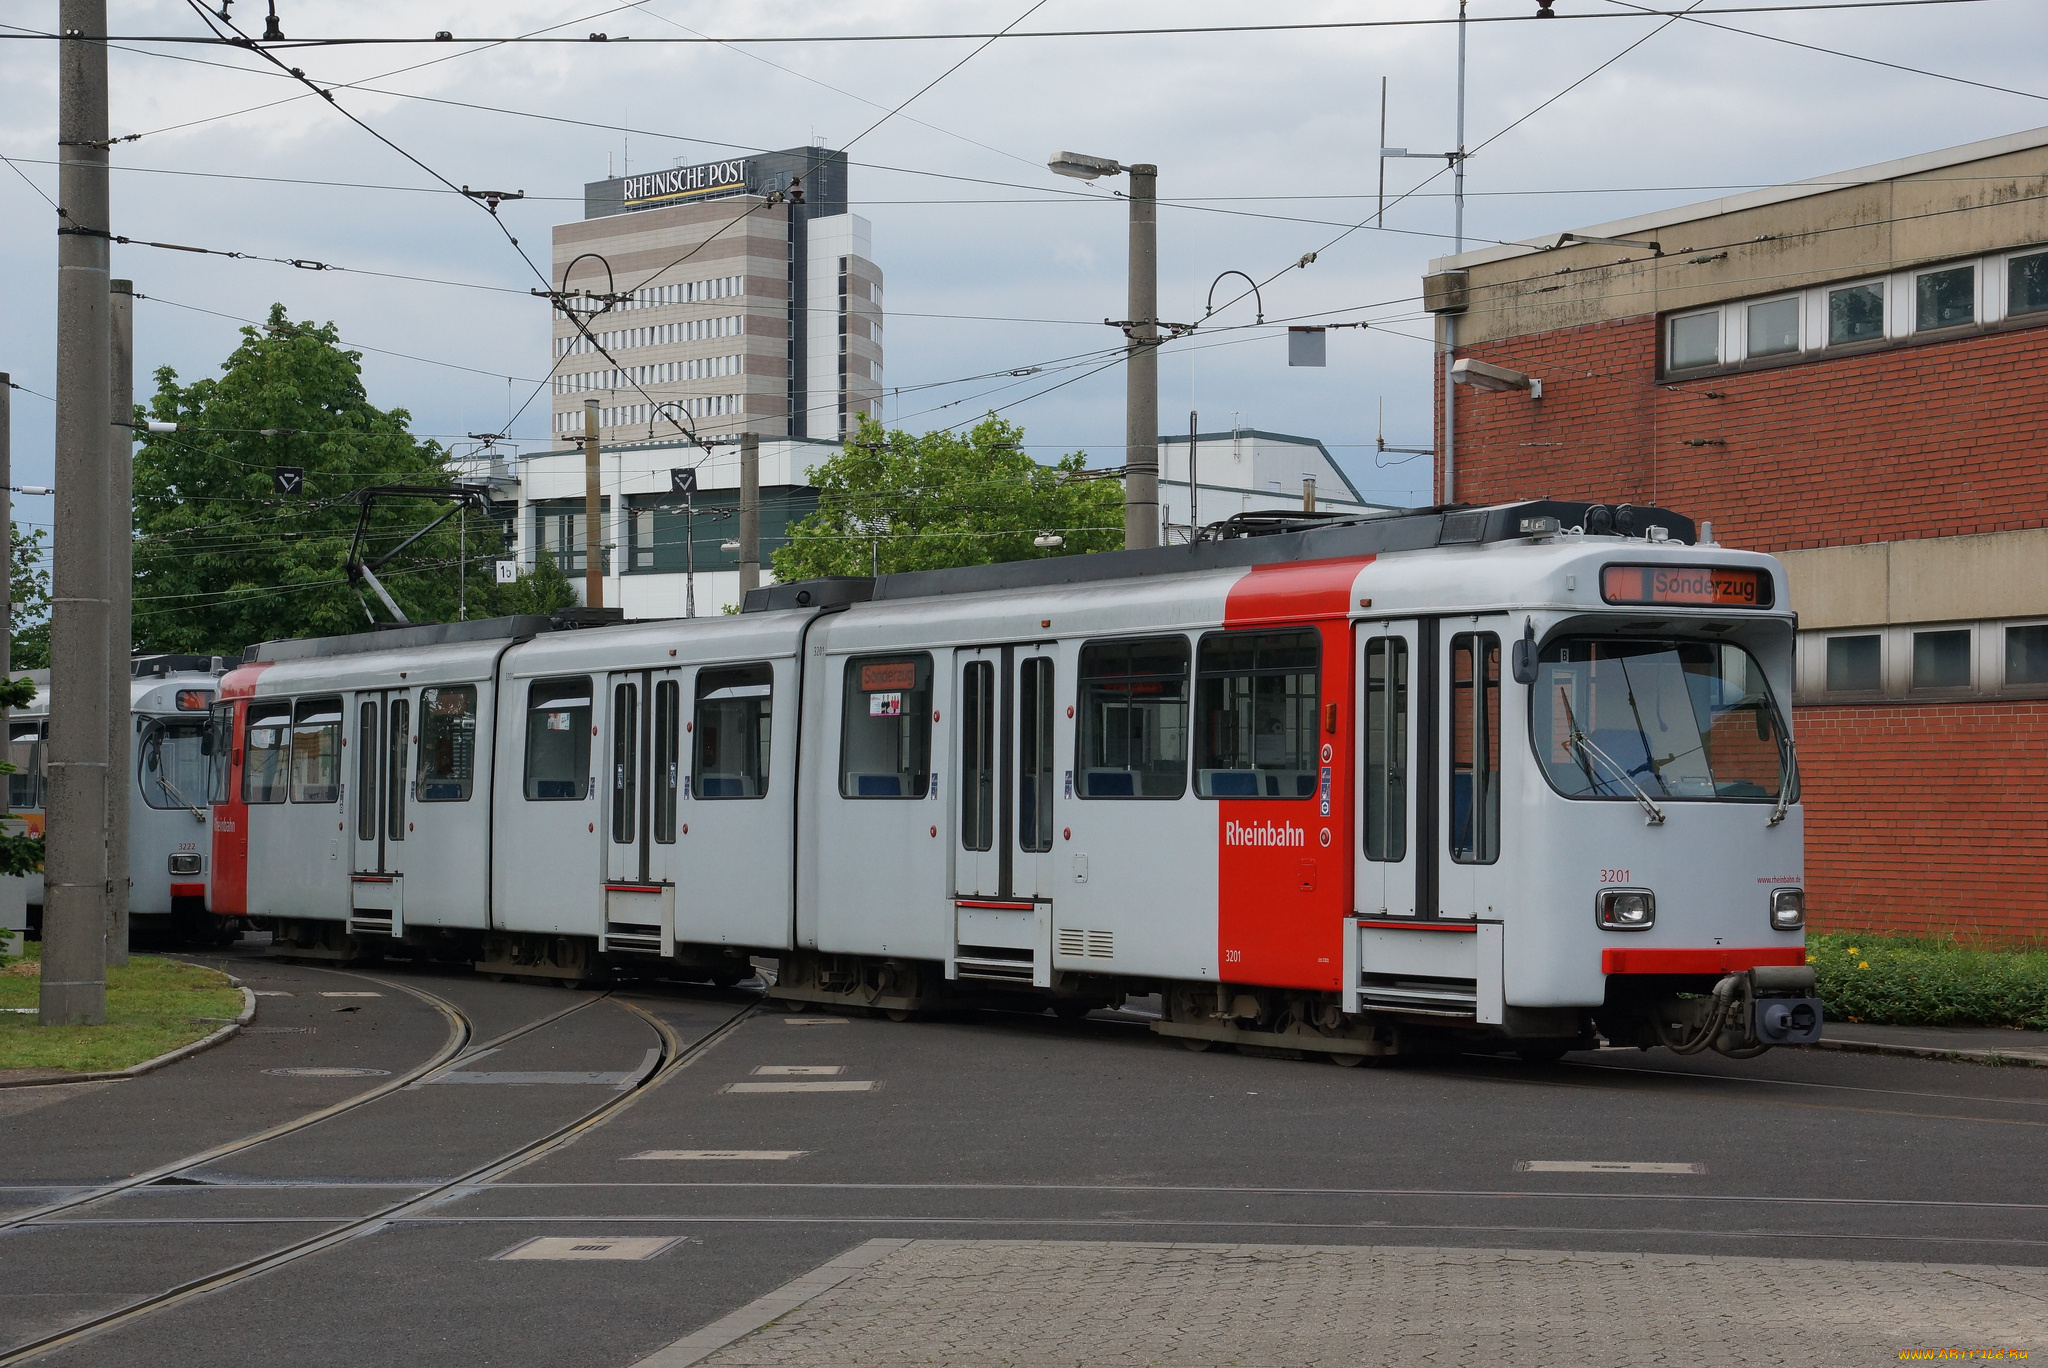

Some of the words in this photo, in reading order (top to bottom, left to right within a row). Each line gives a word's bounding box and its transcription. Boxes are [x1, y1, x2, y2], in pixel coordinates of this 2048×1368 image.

[624, 166, 705, 200] RHEINISCHE
[709, 159, 746, 186] POST
[1655, 572, 1755, 602] Sonderzug
[1562, 650, 1568, 661] B
[864, 668, 913, 686] Sonderzug
[1226, 820, 1304, 847] Rheinbahn
[178, 842, 196, 851] 3222
[1600, 869, 1630, 883] 3201
[1757, 875, 1801, 884] www.rheinbahn.de
[1225, 949, 1241, 963] 3201
